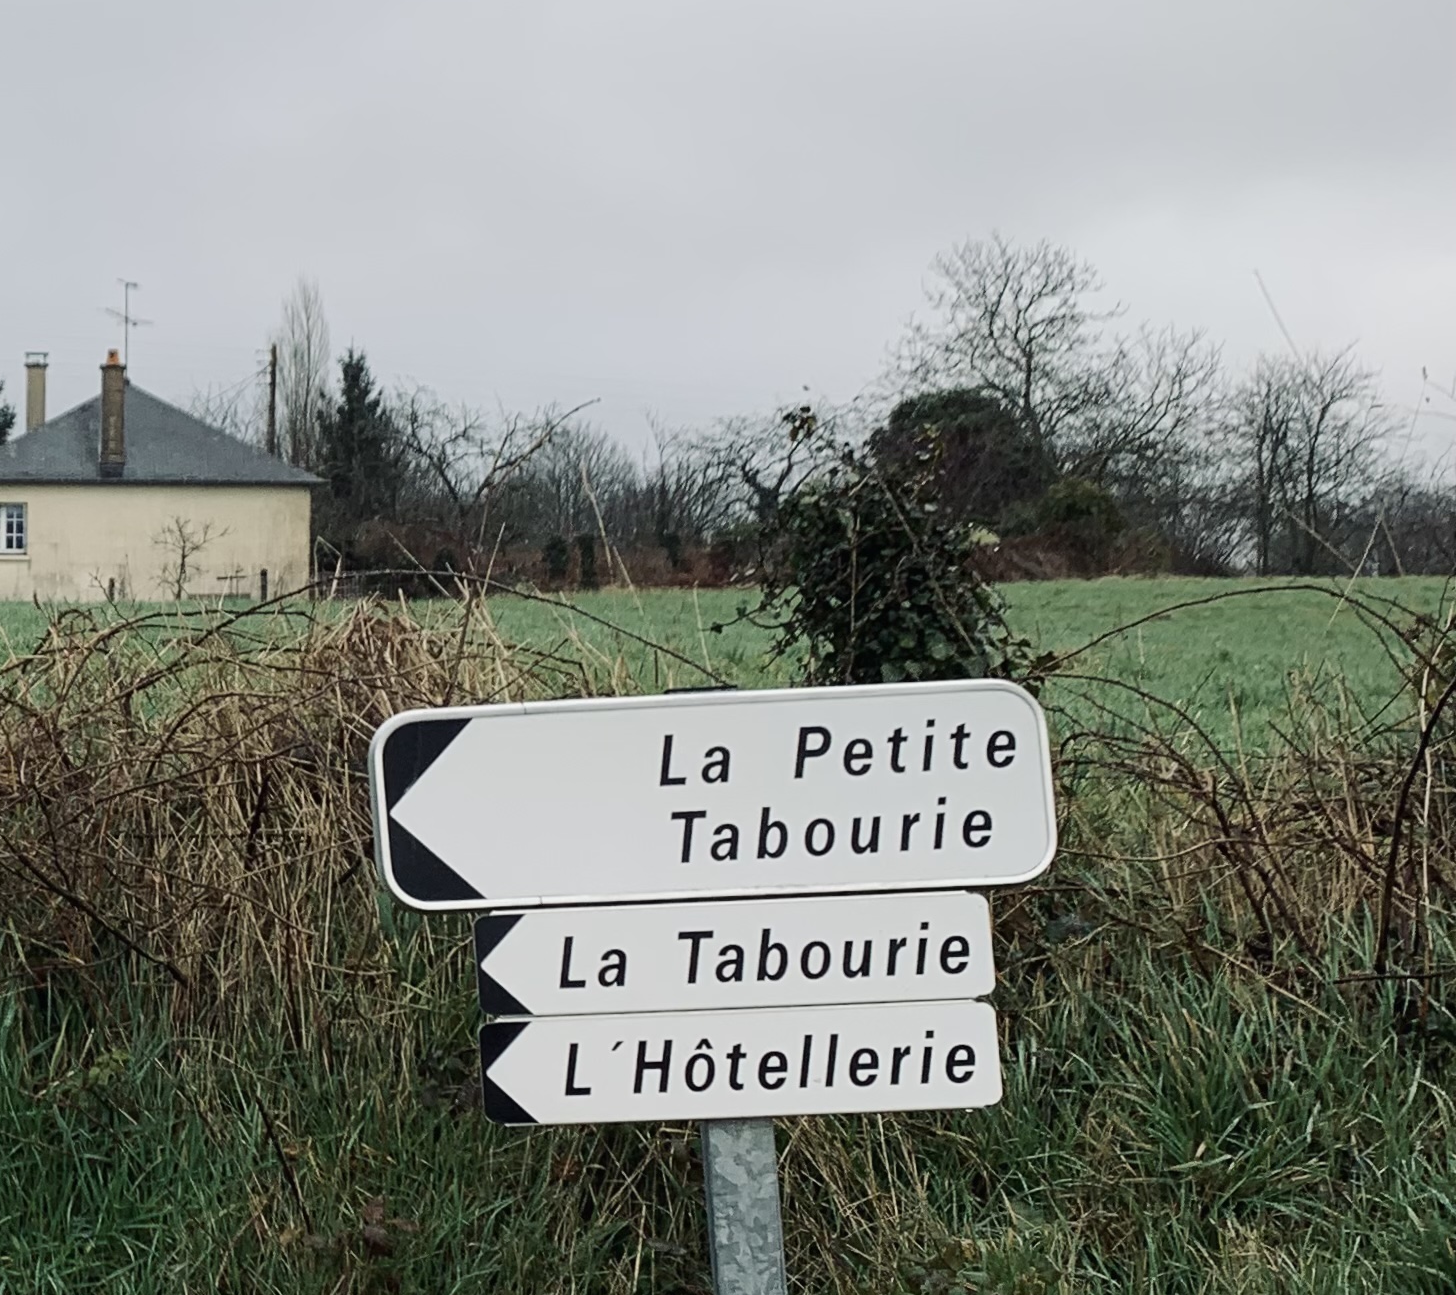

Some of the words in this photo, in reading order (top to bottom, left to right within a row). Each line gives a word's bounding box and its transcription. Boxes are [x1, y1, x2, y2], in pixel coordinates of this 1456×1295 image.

[659, 734, 731, 787] La
[794, 718, 1016, 779] Petite
[670, 796, 993, 864] Tabourie
[559, 936, 627, 989] La
[677, 921, 970, 984] Tabourie
